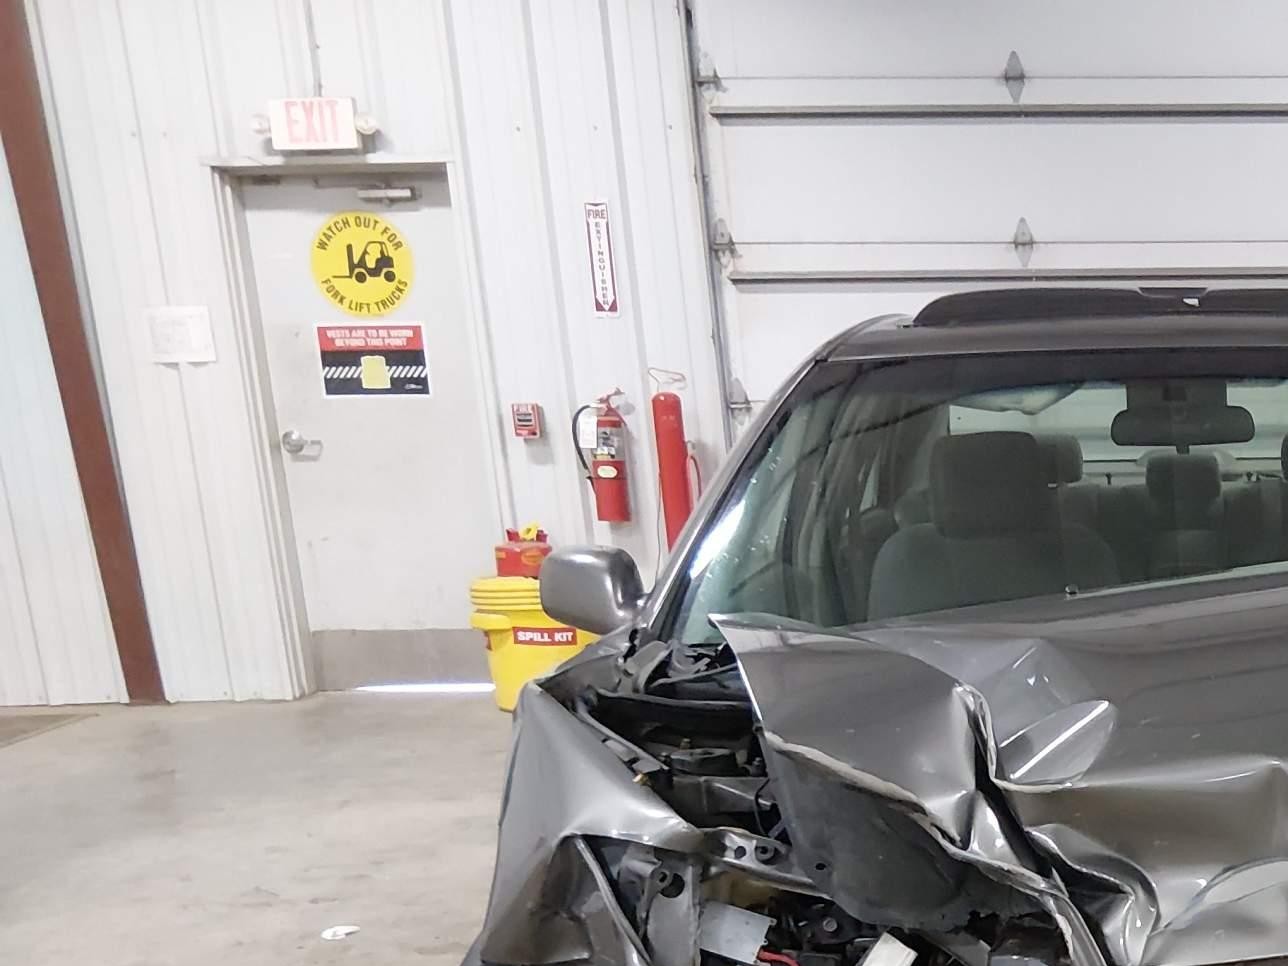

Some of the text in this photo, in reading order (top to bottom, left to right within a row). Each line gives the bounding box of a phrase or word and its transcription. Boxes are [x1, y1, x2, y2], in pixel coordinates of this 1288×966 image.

[284, 100, 339, 143] EXIT
[587, 209, 606, 219] FIRE
[316, 215, 404, 251] WATCH OUT FOR
[321, 278, 408, 313] FORK LIFT TRUCKS
[516, 630, 574, 642] SPILL KIT
